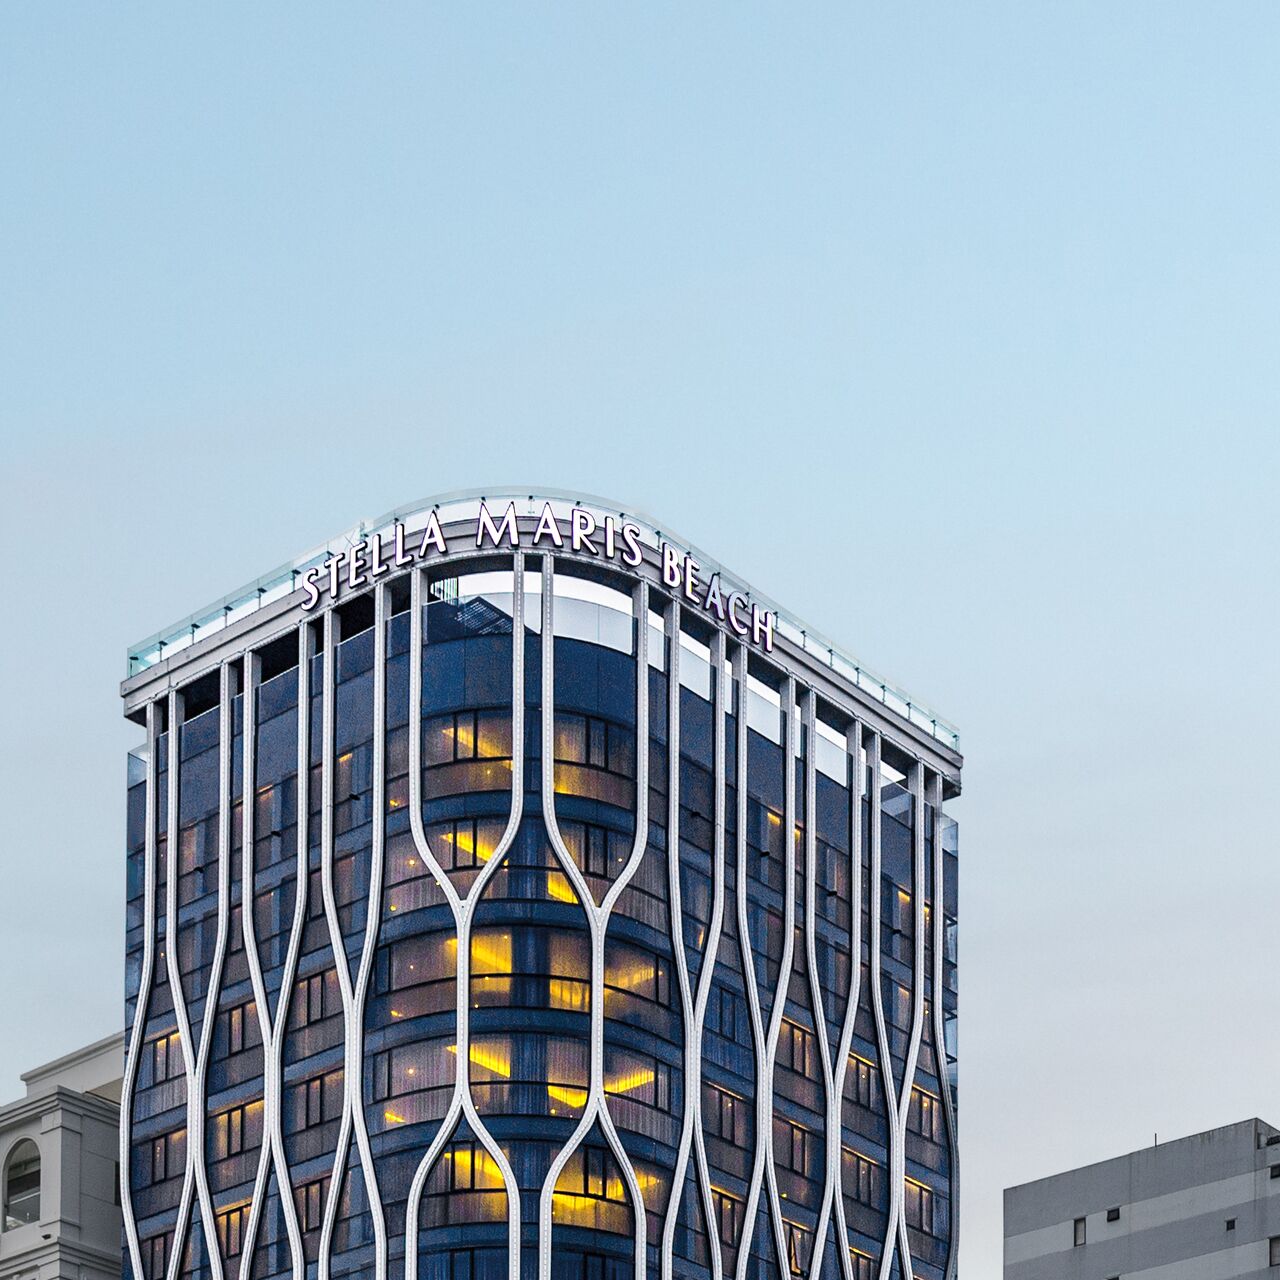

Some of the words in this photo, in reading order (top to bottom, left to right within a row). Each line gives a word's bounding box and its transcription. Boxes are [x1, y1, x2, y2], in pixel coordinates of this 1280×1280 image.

[300, 510, 448, 611] STELLA
[476, 501, 646, 567] MARIS
[659, 543, 775, 653] BEACH
